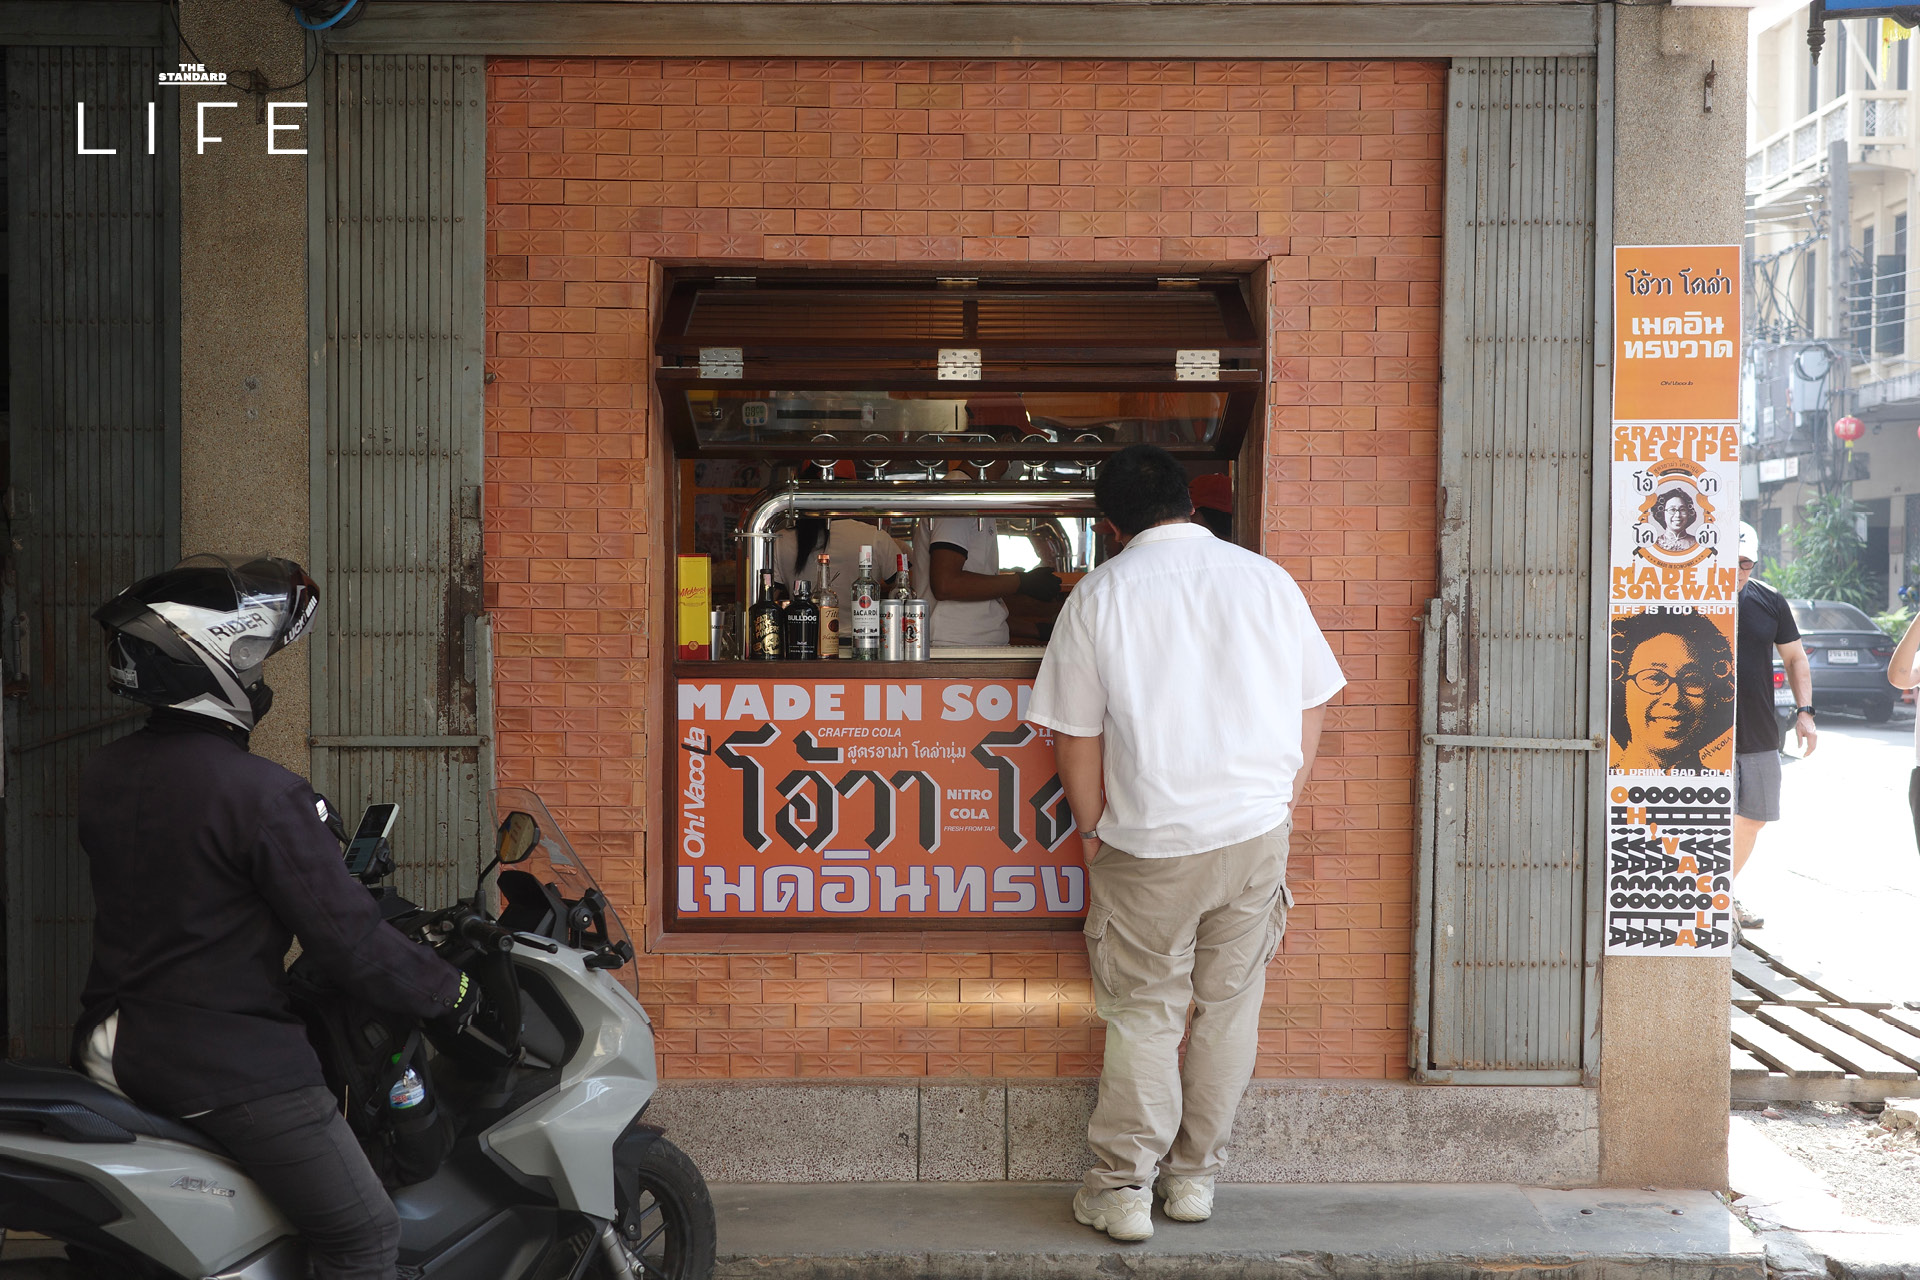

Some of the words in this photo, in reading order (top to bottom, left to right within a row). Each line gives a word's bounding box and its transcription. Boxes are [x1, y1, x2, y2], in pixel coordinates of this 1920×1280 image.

[1632, 311, 1724, 335] เมดอิน
[1624, 340, 1733, 359] ทรงวาด
[1614, 426, 1738, 441] GRANDMA
[1614, 440, 1738, 461] RECIPE
[1612, 567, 1697, 585] MADE
[1707, 567, 1736, 590] IN
[1612, 584, 1736, 600] SONGWAT
[1611, 605, 1640, 614] LIFE
[1645, 605, 1659, 614] IS
[1664, 605, 1692, 614] TOO
[1697, 605, 1735, 614] SHOT
[208, 612, 268, 641] RIDER
[678, 684, 845, 721] MADE
[864, 684, 922, 721] IN
[817, 727, 869, 738] CRAFTED
[872, 727, 902, 738] COLA
[1610, 768, 1625, 777] TO
[1629, 768, 1666, 777] DRINK
[1670, 768, 1696, 777] BAD
[1700, 768, 1731, 777] COLA
[949, 808, 990, 820] COLA
[683, 811, 706, 858] Oh!
